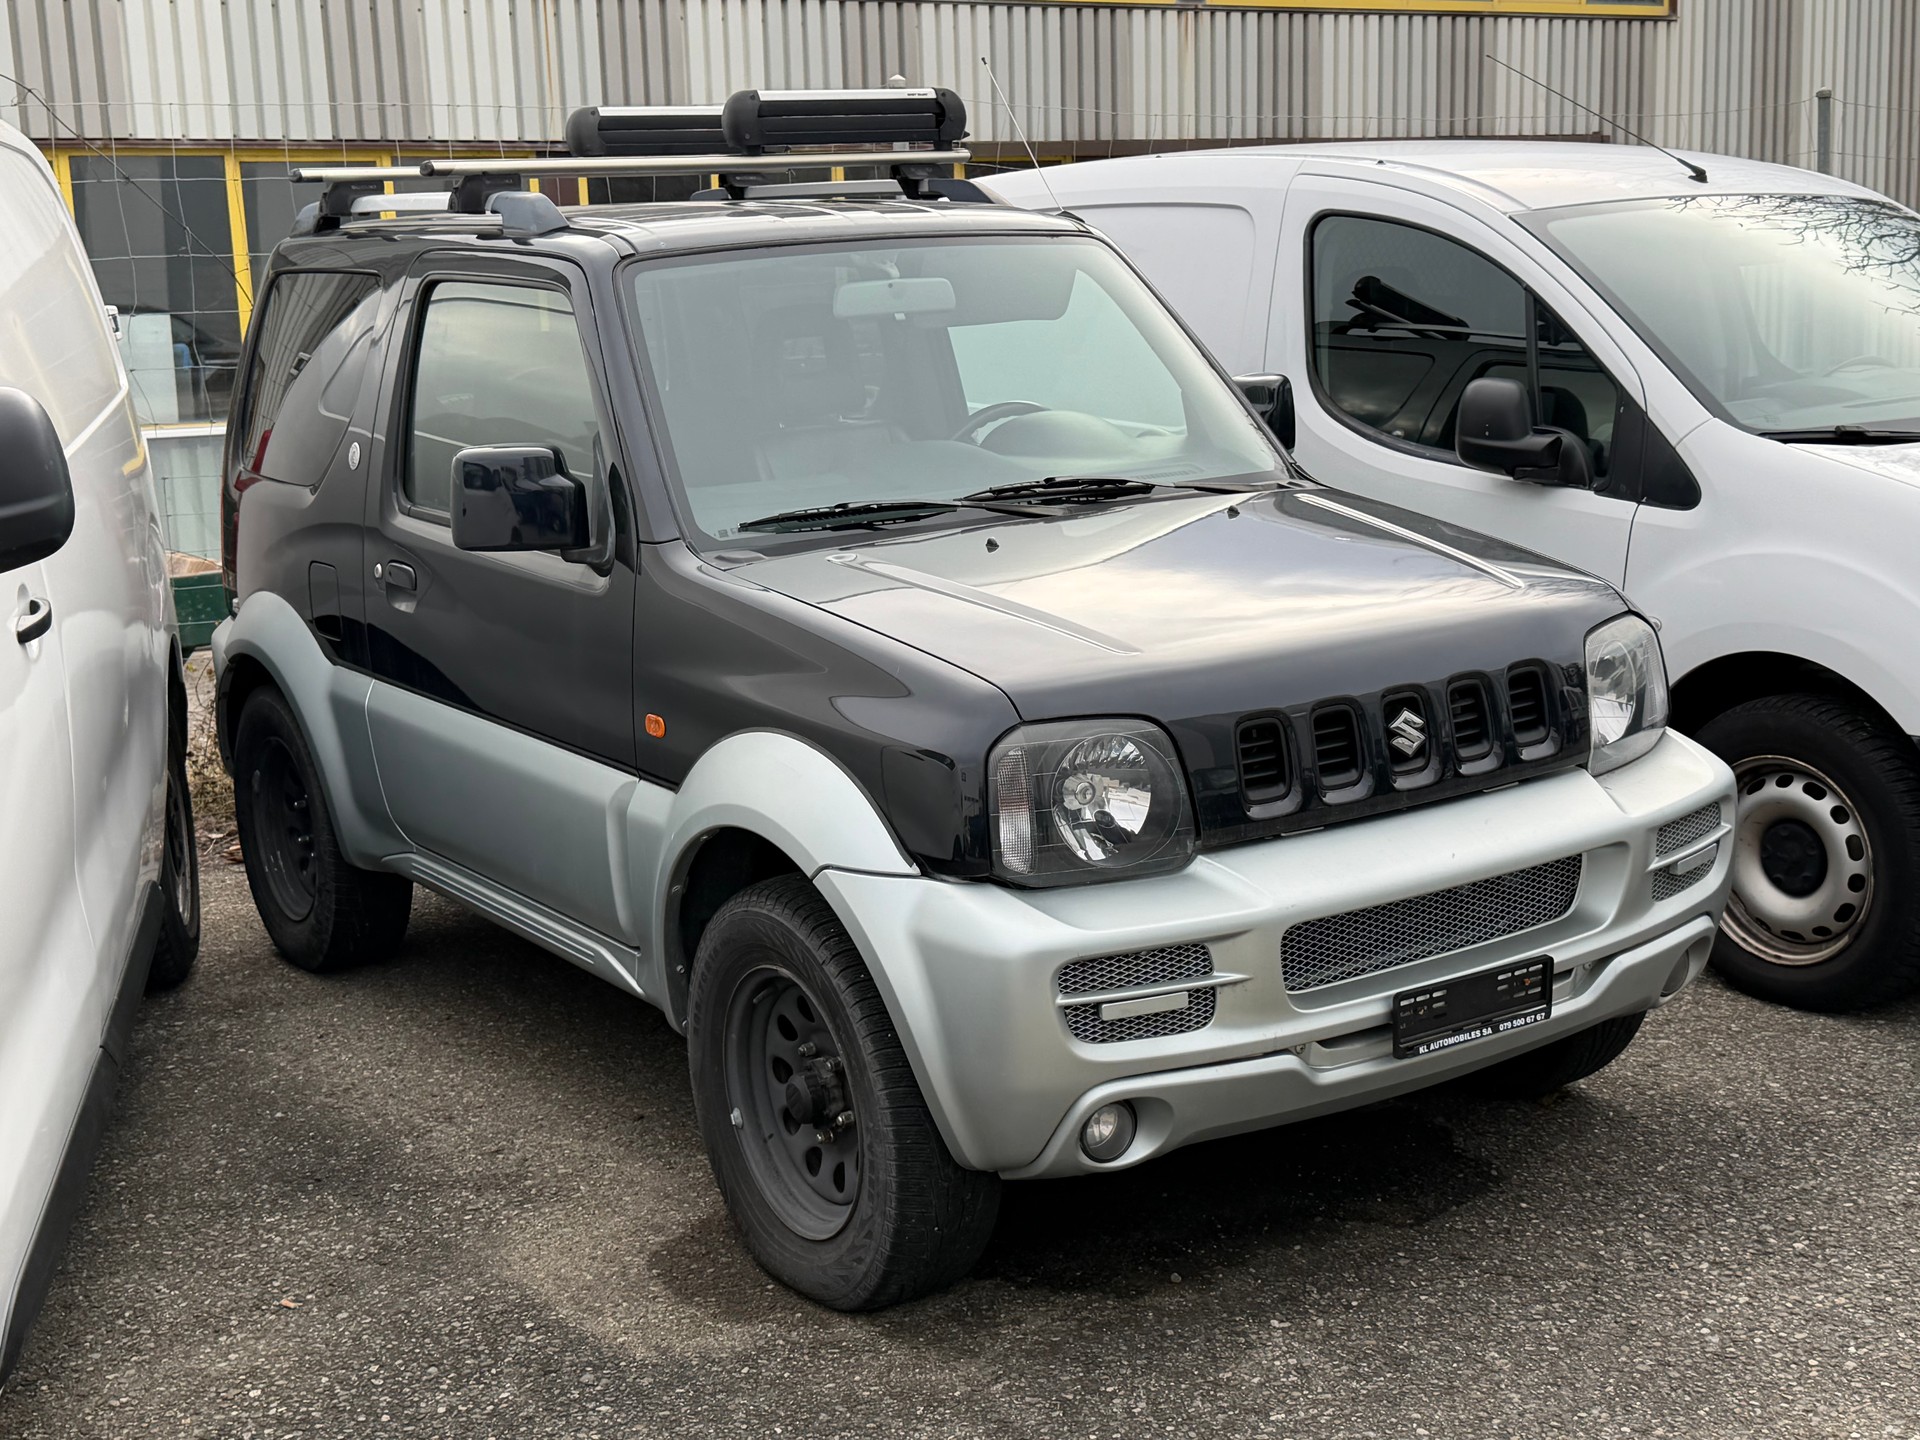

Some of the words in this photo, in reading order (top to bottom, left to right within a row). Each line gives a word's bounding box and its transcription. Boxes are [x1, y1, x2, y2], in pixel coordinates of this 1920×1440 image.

[1419, 1045, 1429, 1054] KL
[1429, 1030, 1481, 1051] AUTOMOBILES
[1482, 1027, 1493, 1036] SA
[1499, 1021, 1512, 1031] 079
[1512, 1017, 1525, 1027] 500
[1526, 1015, 1535, 1023] 67
[1536, 1012, 1546, 1021] 67
